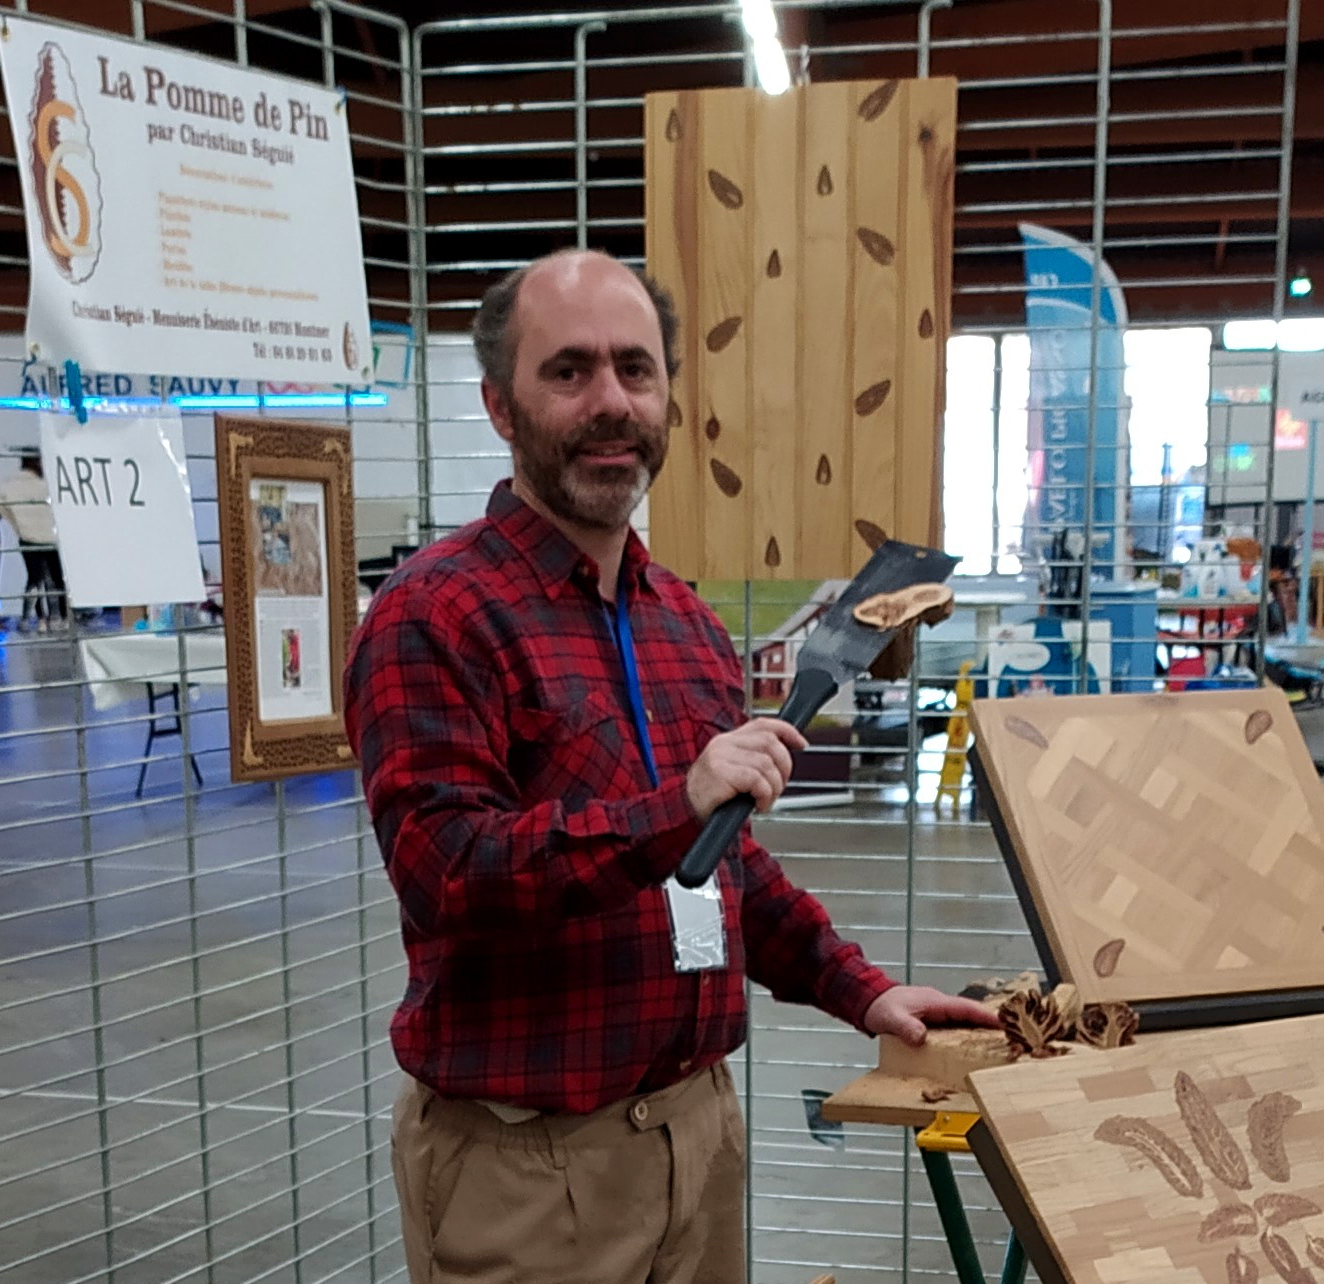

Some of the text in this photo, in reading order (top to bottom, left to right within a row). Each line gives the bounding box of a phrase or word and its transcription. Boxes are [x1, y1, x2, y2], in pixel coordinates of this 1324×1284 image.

[97, 54, 330, 142] La Pomme de Pin
[146, 122, 174, 145] par
[180, 122, 248, 156] Christian
[21, 373, 132, 396] ALFRED
[150, 375, 240, 397] SAUVY
[56, 456, 146, 508] ART 2
